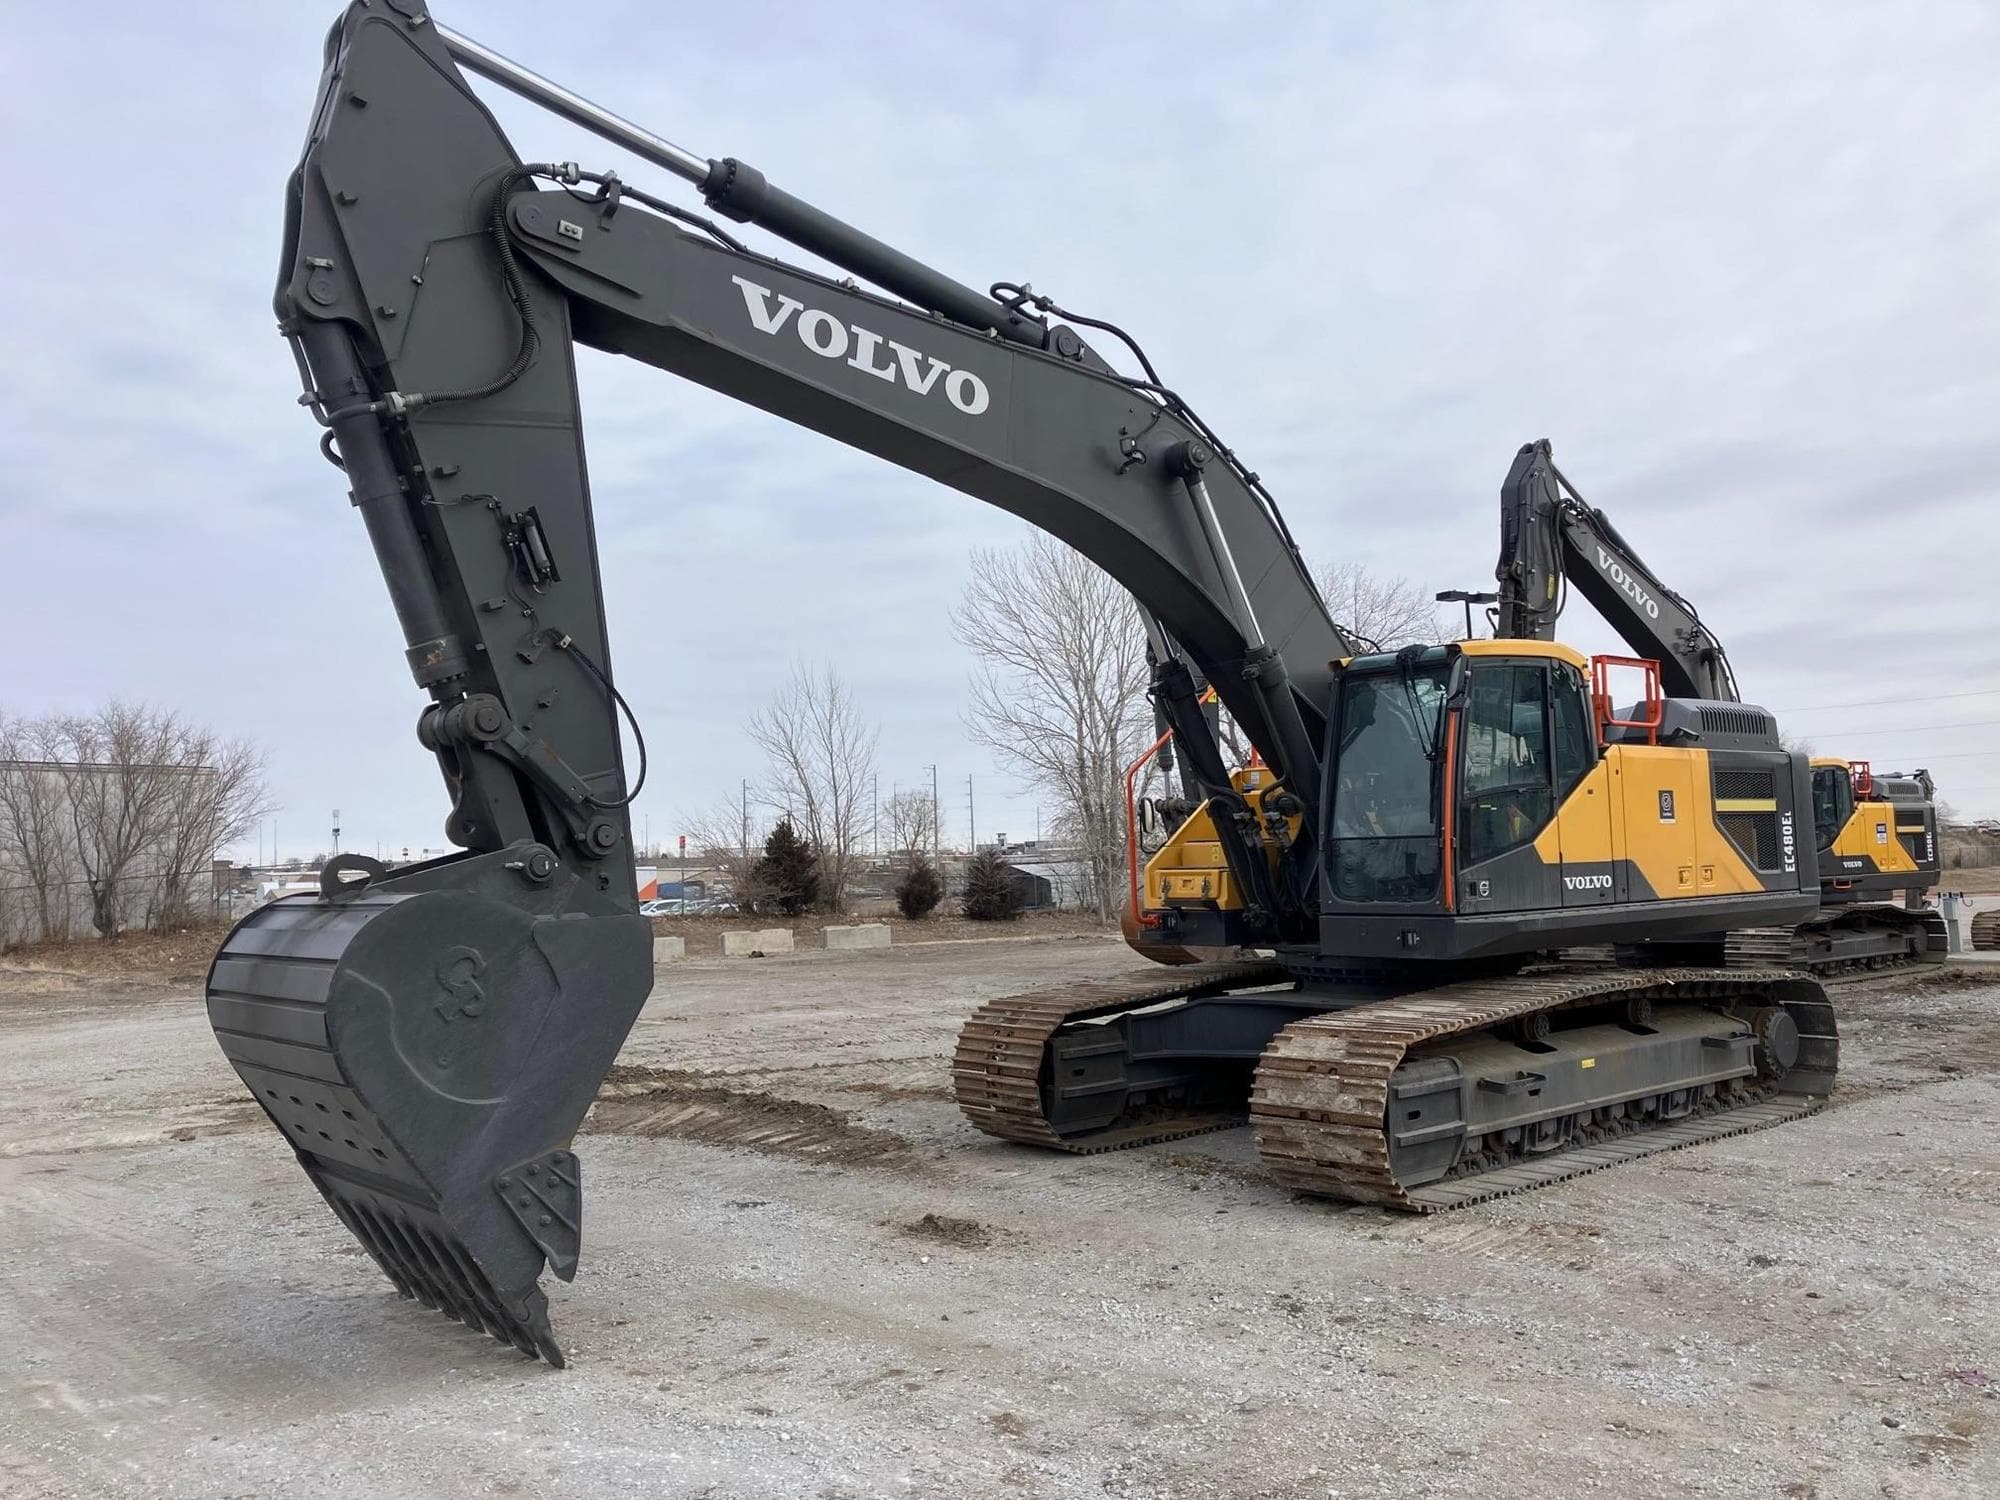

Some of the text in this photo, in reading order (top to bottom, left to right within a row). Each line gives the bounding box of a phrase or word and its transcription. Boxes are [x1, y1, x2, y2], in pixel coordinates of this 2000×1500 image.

[731, 275, 990, 415] VOLVO
[1597, 546, 1659, 619] VOLVO
[1781, 810, 1796, 873] EC480EL
[1564, 875, 1612, 890] VOLVO
